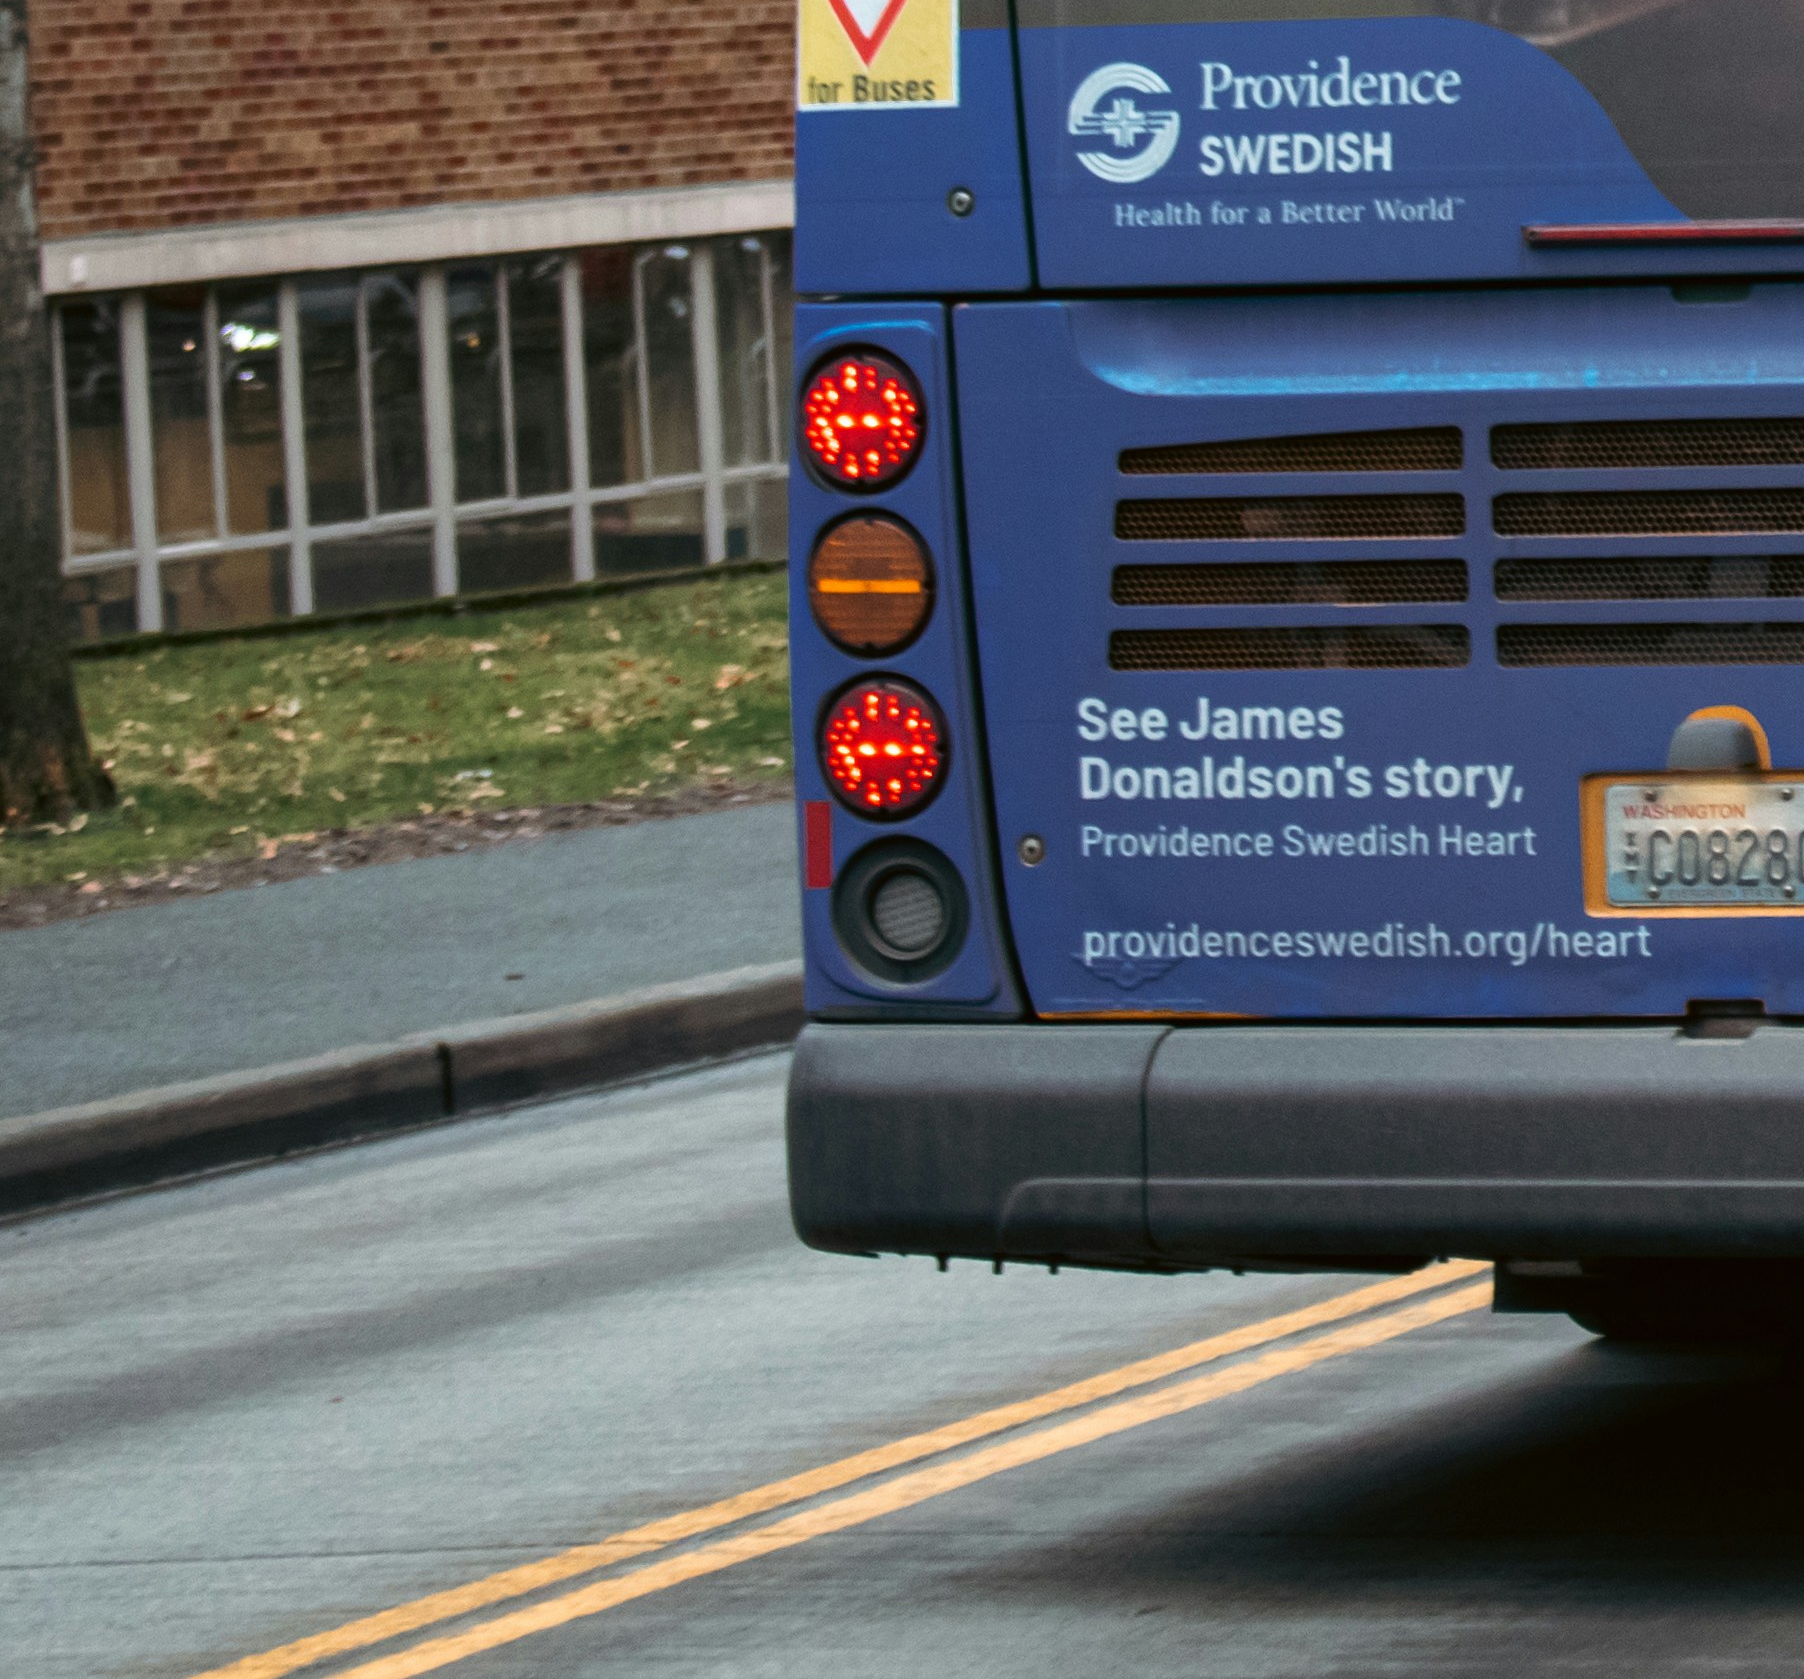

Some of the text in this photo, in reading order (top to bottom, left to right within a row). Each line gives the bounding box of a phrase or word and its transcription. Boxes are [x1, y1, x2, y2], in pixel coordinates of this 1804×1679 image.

[808, 75, 936, 103] for Buses
[1199, 55, 1462, 110] Providence
[1199, 131, 1393, 176] SWEDISH
[1114, 202, 1201, 227] Health
[1211, 200, 1249, 224] for
[1257, 207, 1272, 224] a
[1281, 200, 1365, 224] Better
[1078, 697, 1345, 741] See James
[1079, 756, 1524, 809] Donaldson's story,
[1623, 804, 1746, 819] WASHINGTON
[1081, 824, 1538, 857] Providence Swedish Heart
[1084, 923, 1651, 967] providenceswedish.org/heart
